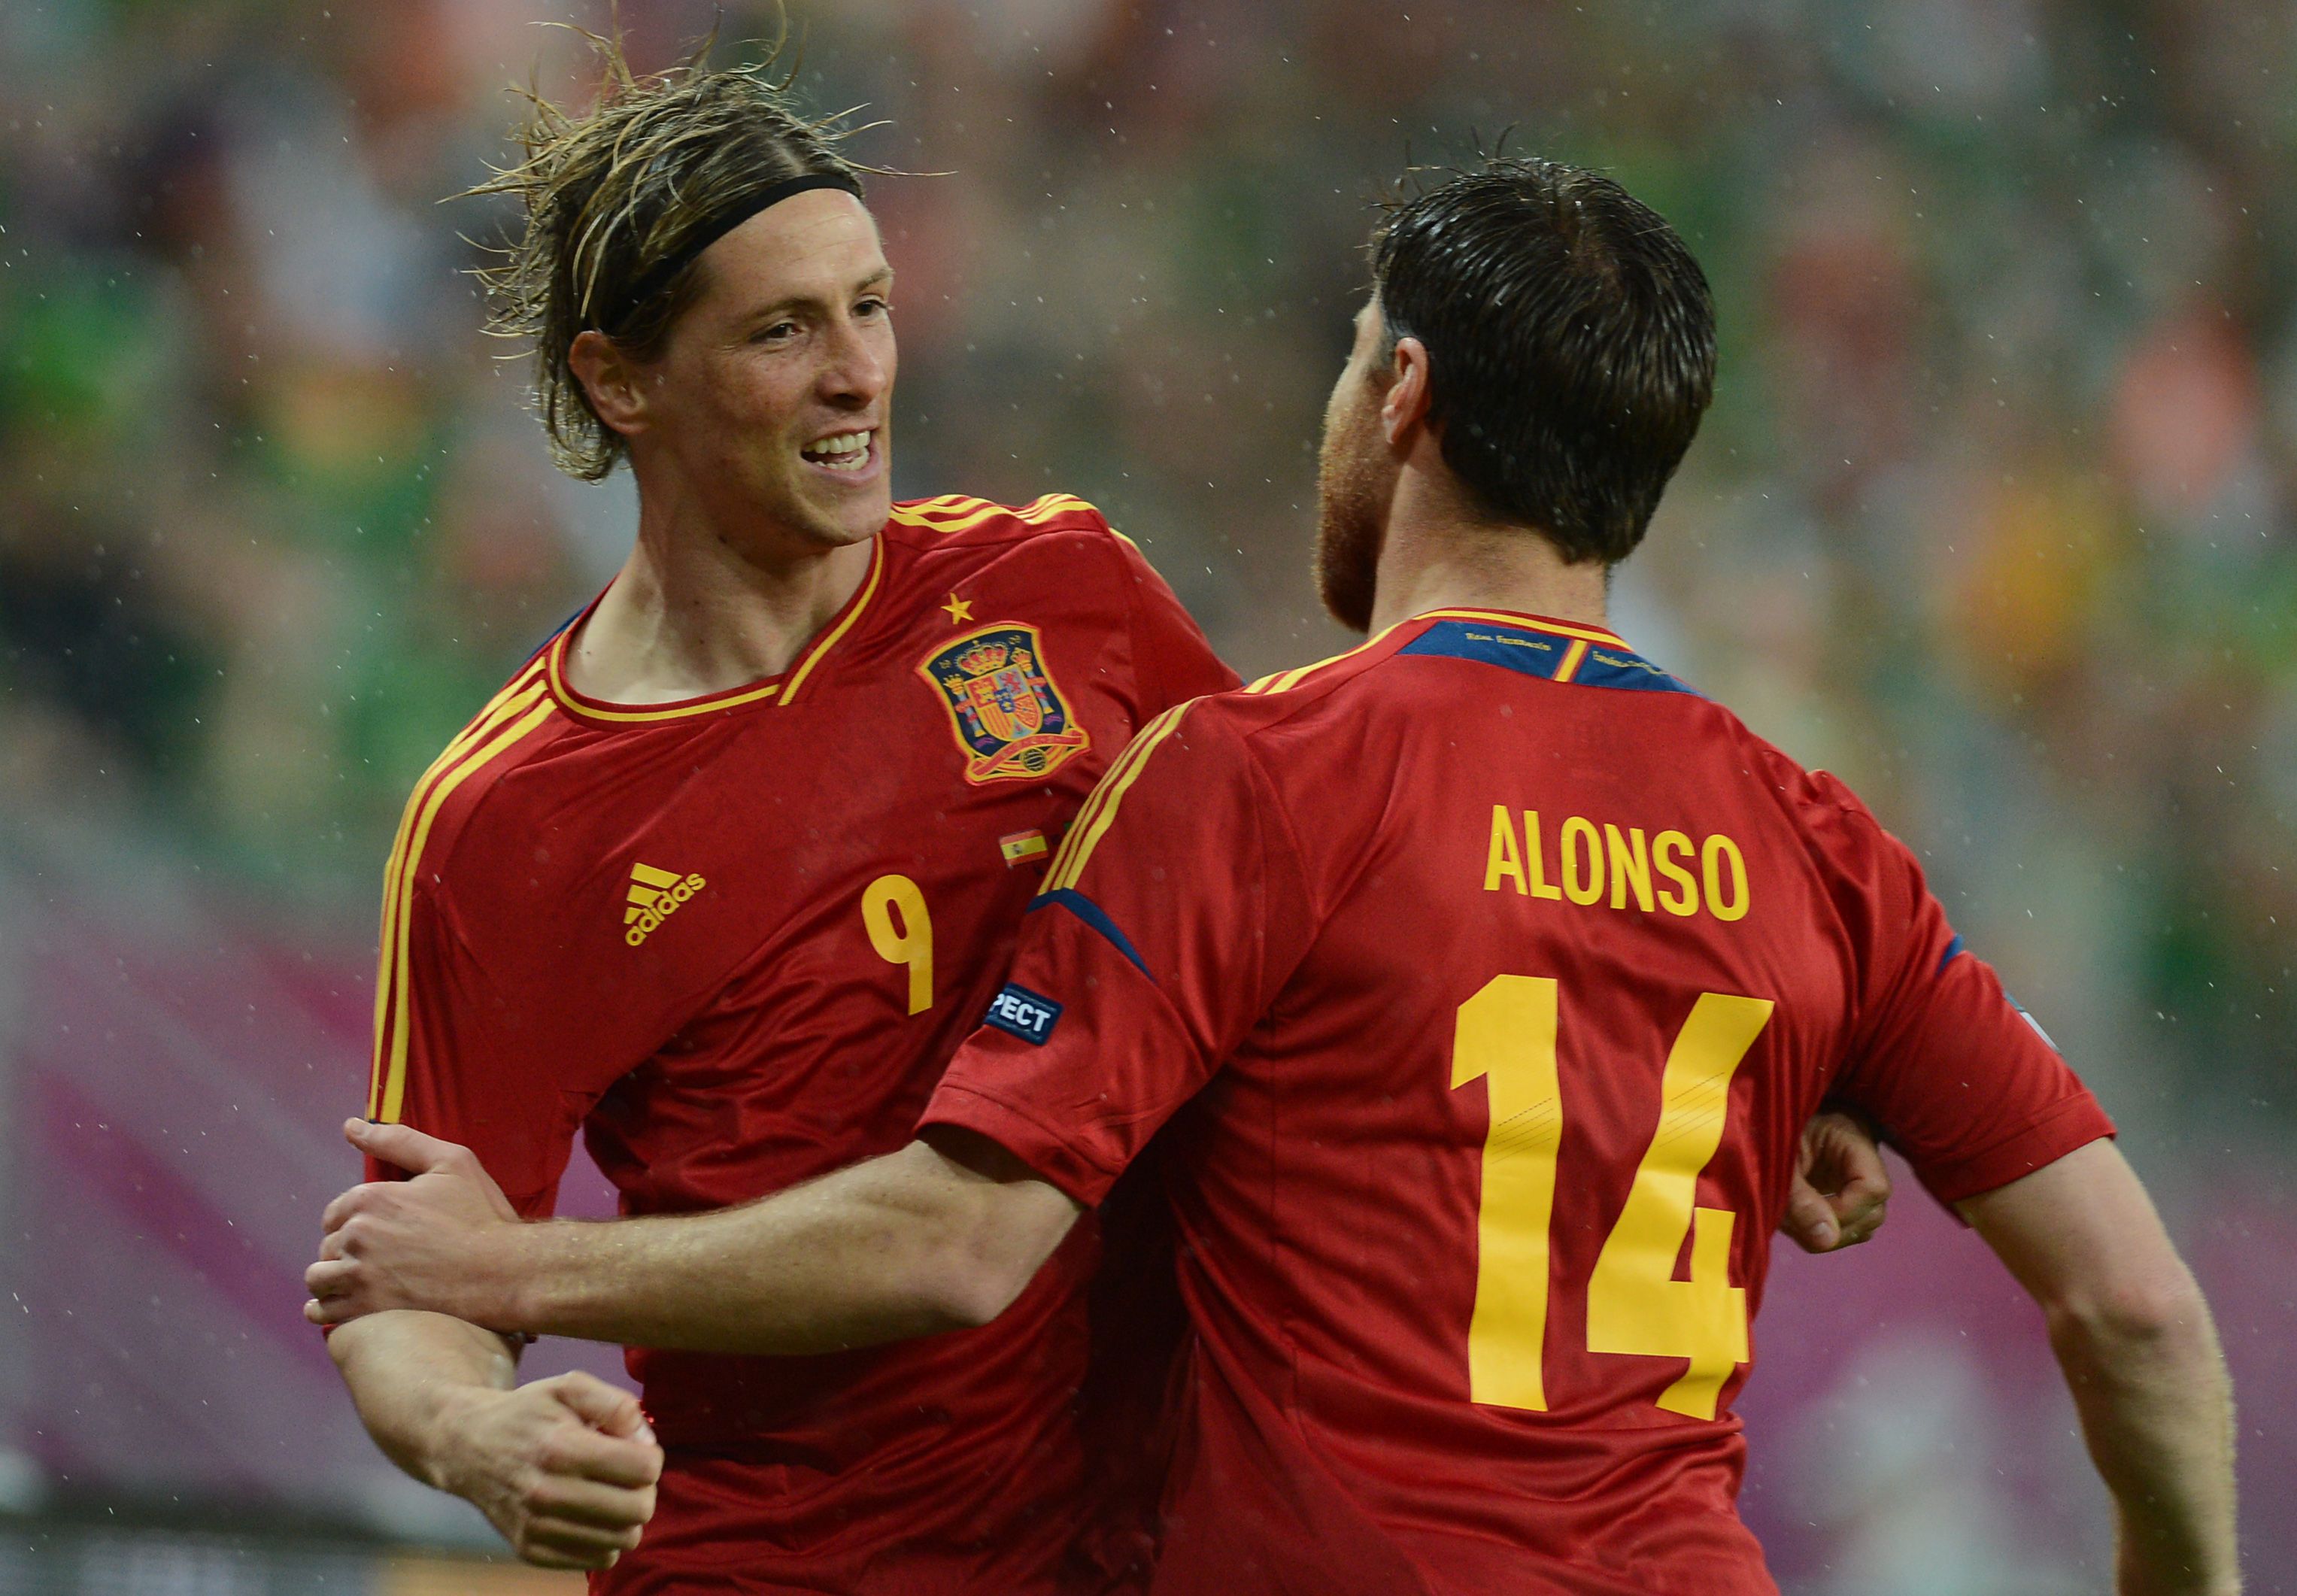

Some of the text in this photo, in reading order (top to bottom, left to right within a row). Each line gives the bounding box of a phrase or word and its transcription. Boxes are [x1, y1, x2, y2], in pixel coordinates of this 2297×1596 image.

[625, 872, 706, 946] adidas
[1483, 804, 1750, 921] ALONSO
[860, 874, 933, 1015] 9
[1450, 974, 1775, 1422] 14
